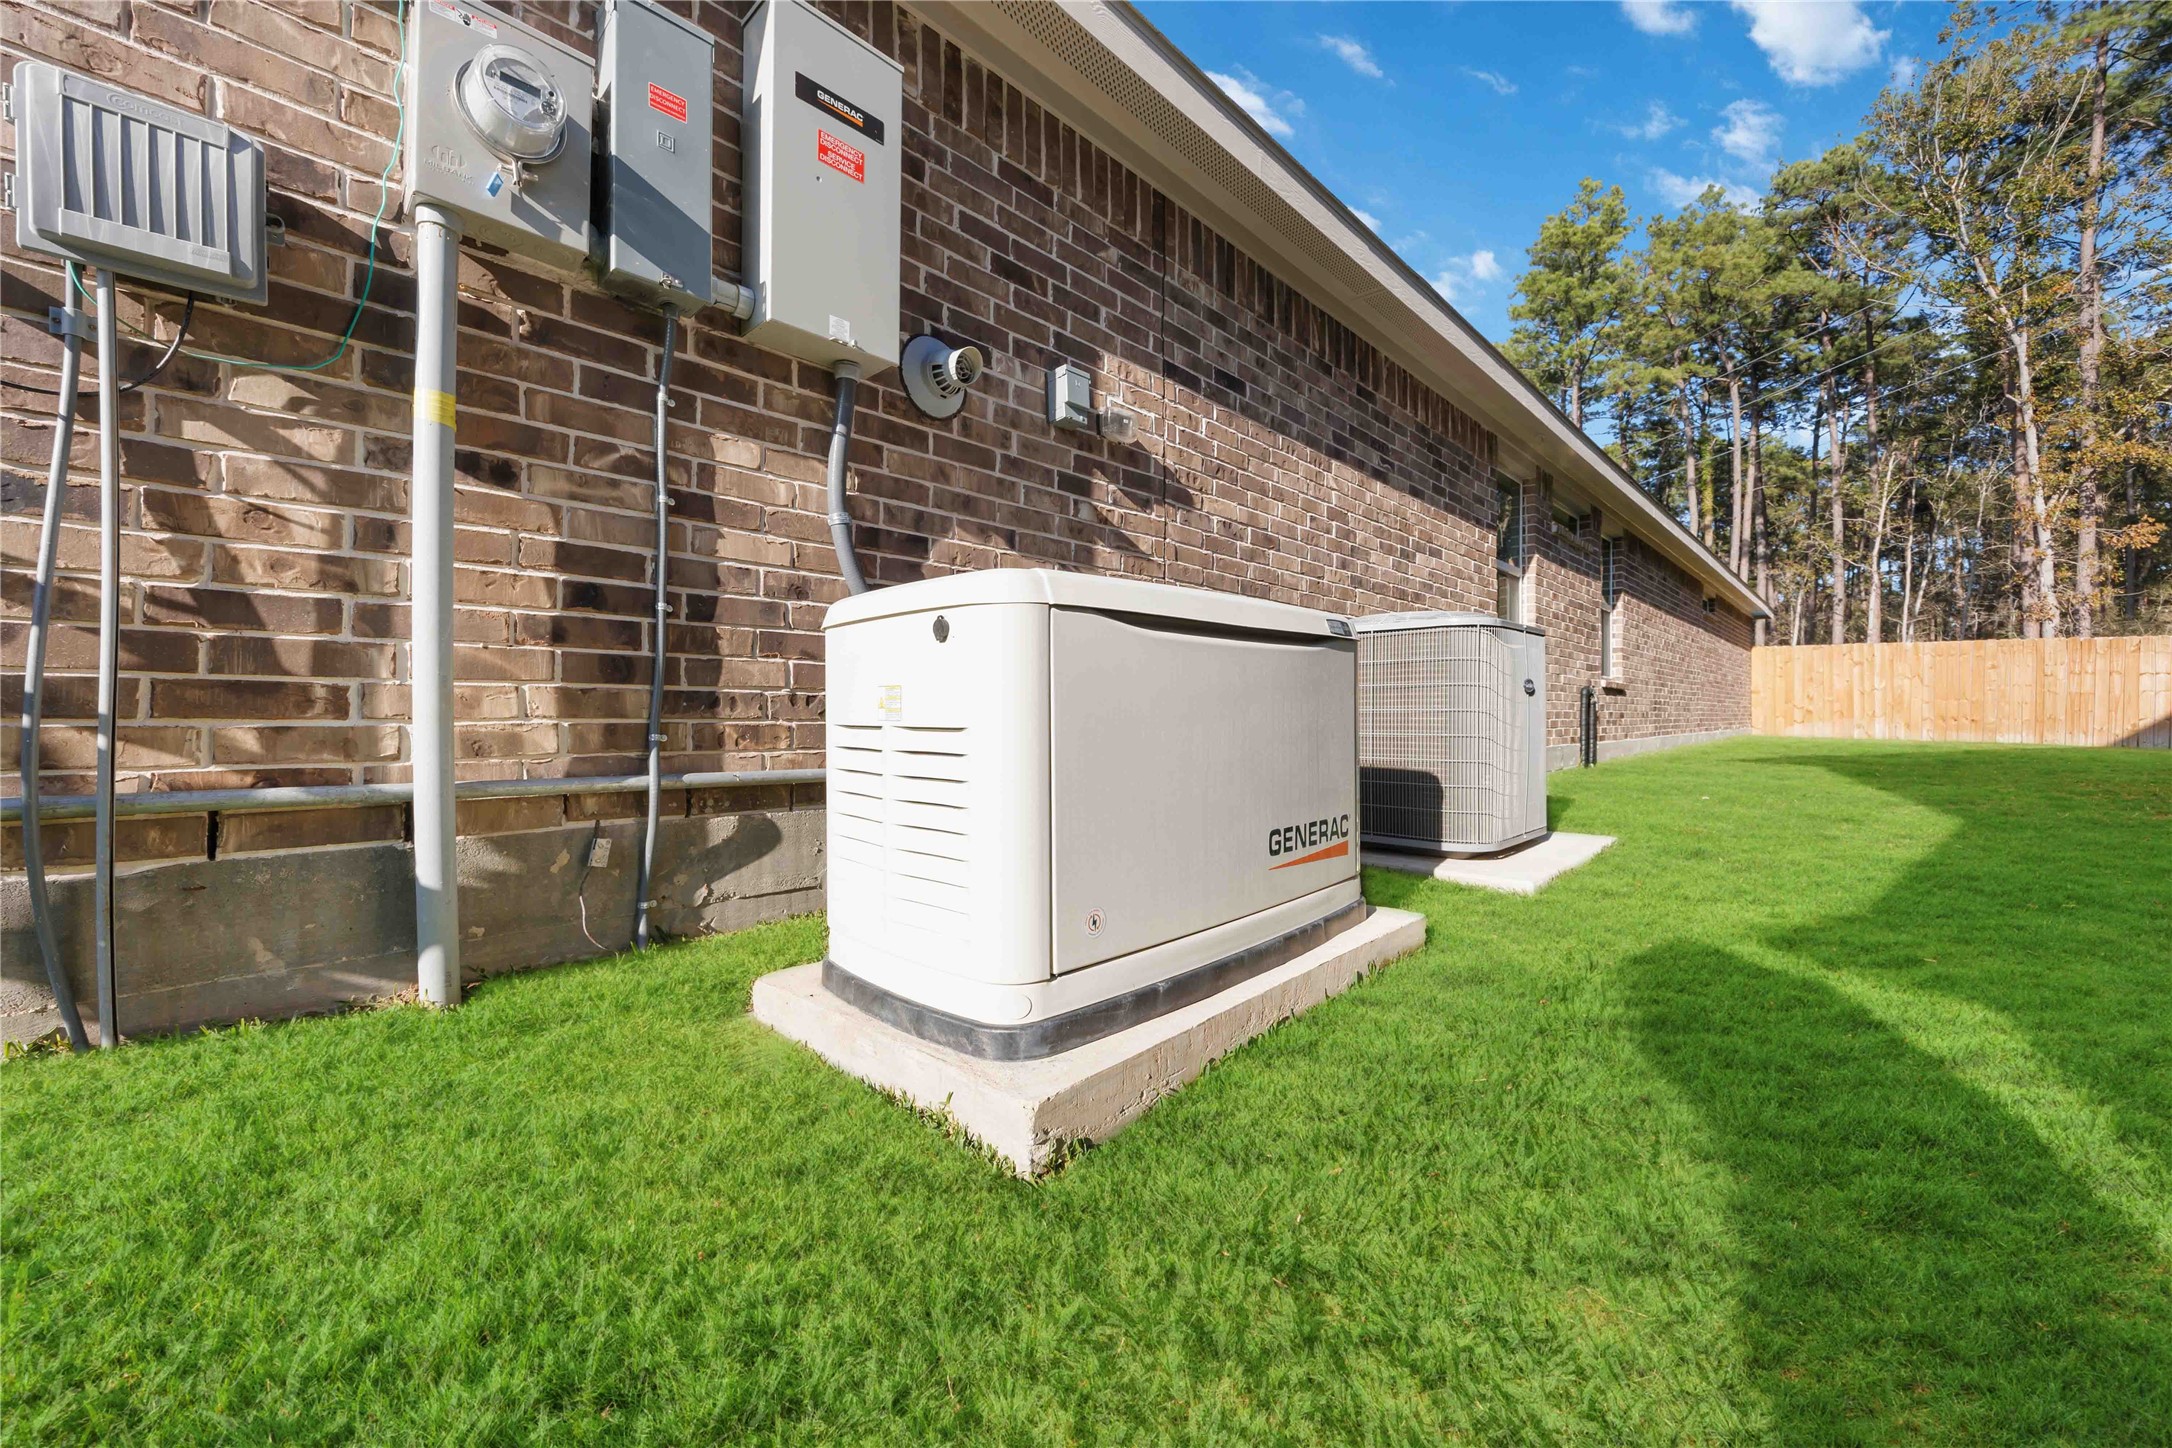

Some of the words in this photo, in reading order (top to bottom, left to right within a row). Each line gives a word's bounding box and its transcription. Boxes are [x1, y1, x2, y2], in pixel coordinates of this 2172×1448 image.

[650, 86, 685, 106] EMERGENCY
[650, 94, 686, 115] DISCONNECT
[817, 90, 864, 122] GENERAC
[820, 131, 862, 158] EMERGENCY
[820, 138, 863, 165] DISCONNECT
[820, 153, 862, 180] DISCONNECT
[827, 151, 856, 171] SERVICE
[1268, 813, 1349, 857] GENERAC
